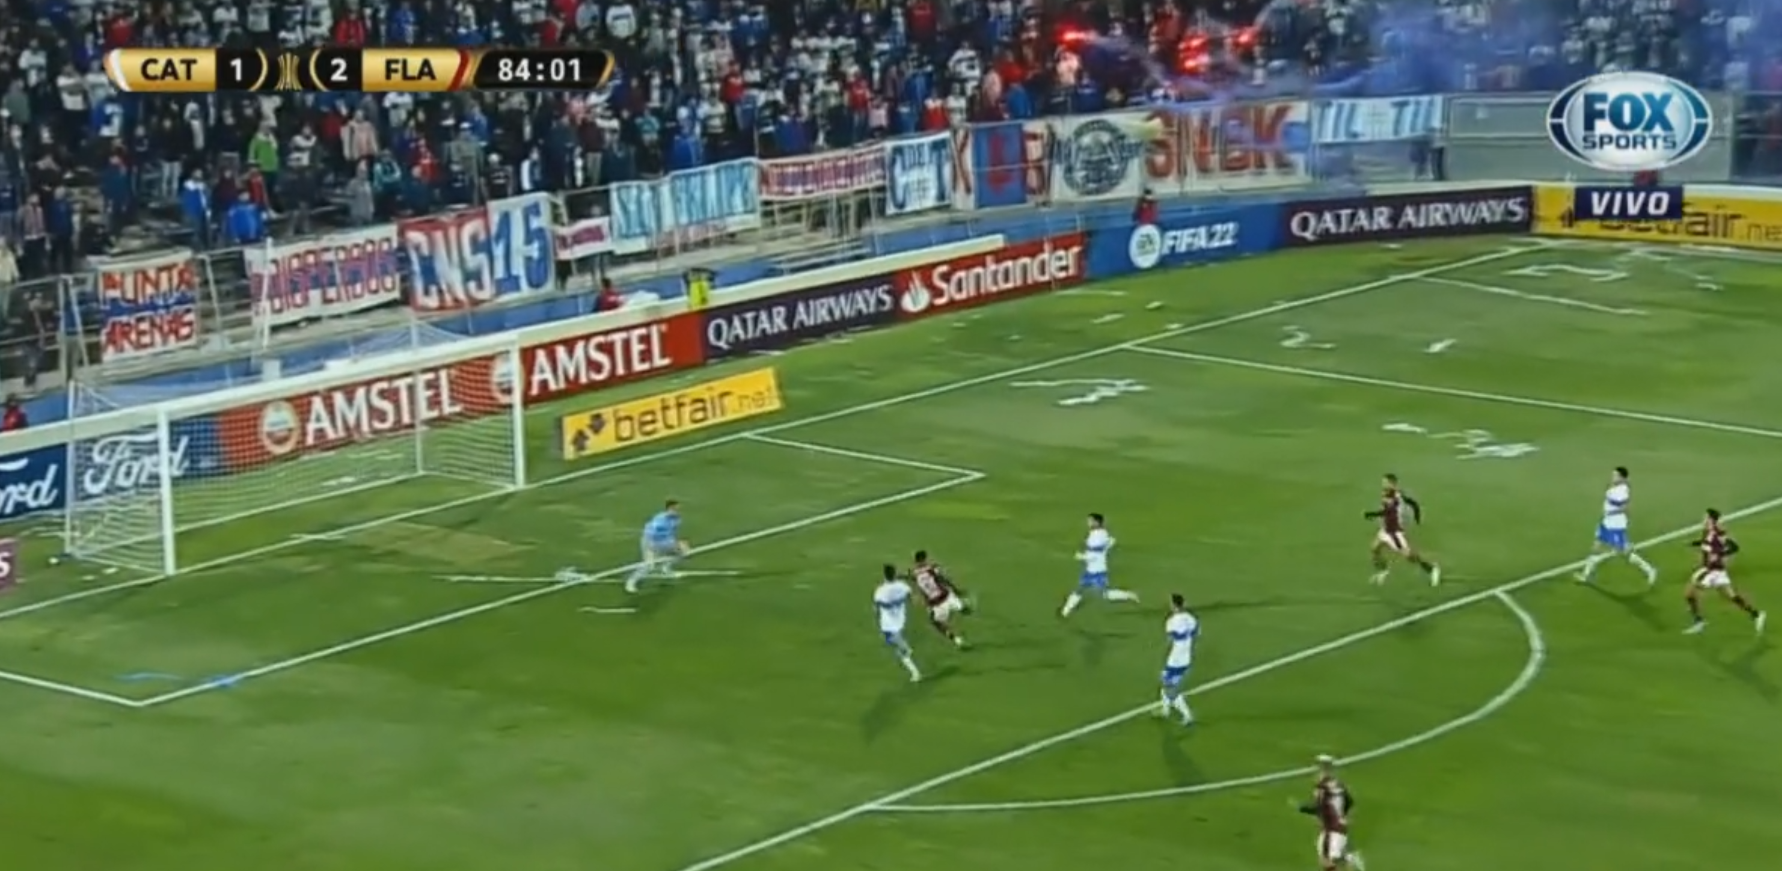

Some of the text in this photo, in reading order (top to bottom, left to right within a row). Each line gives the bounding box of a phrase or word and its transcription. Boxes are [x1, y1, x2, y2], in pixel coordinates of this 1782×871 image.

[1161, 221, 1239, 255] FIFA 22
[1290, 196, 1526, 242] QATAR AIRWAYS
[931, 241, 1083, 306] Santander
[706, 283, 893, 349] QATAR AIRWAYS
[530, 327, 672, 397] AMSTEL
[305, 368, 462, 446] AMSTEL
[0, 457, 58, 515] rd
[84, 431, 190, 495] Ford
